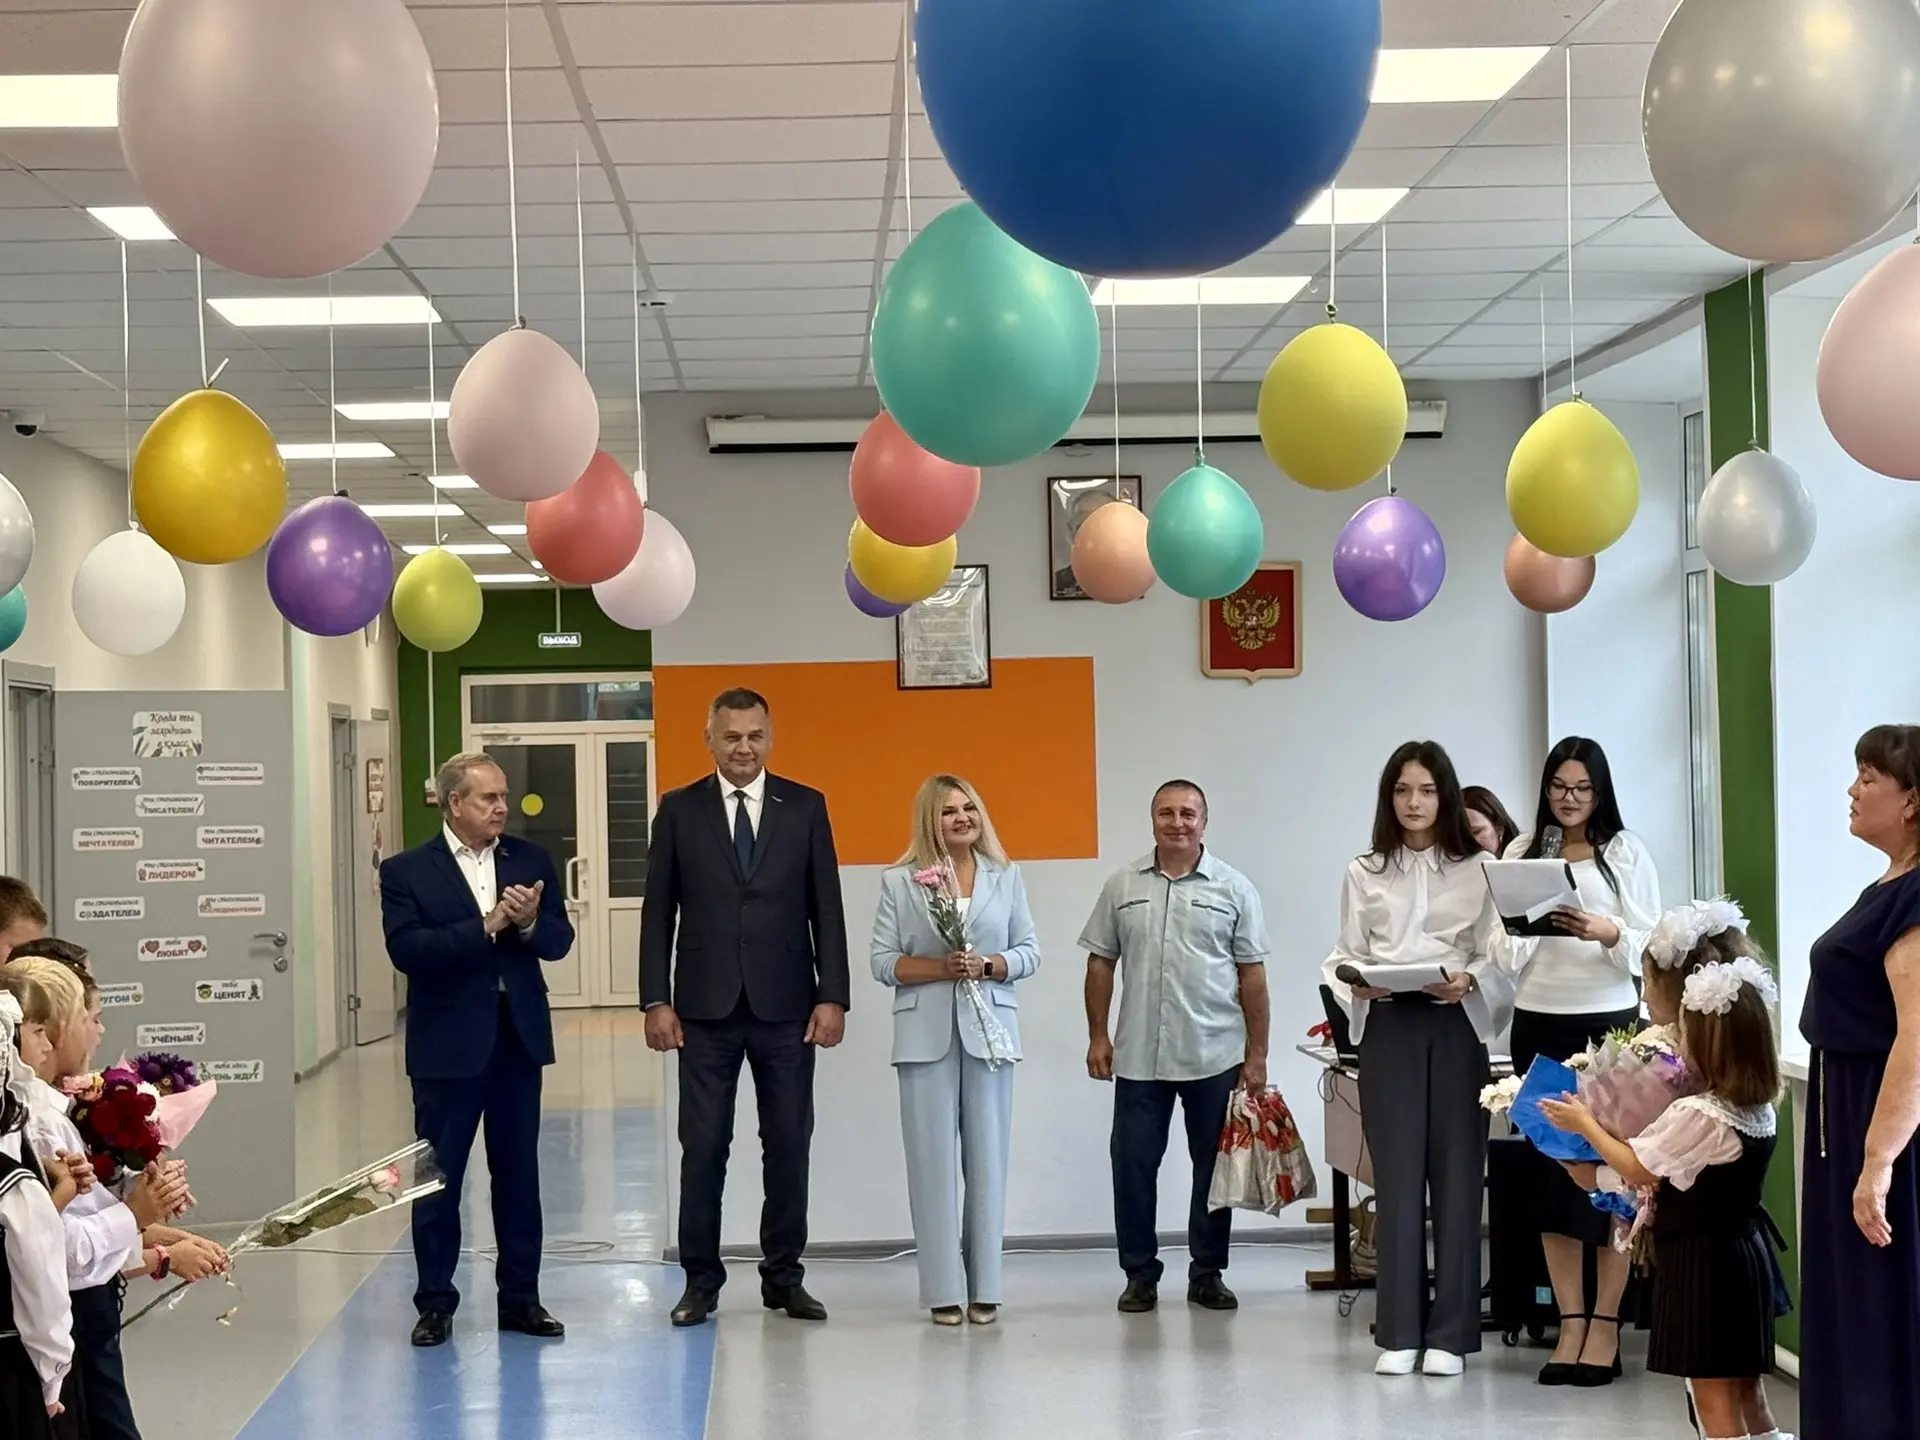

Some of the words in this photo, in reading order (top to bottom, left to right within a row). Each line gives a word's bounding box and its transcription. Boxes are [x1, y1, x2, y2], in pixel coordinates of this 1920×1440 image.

[542, 636, 579, 645] ВЫХОД
[149, 711, 177, 724] Когда
[179, 713, 195, 722] ты
[78, 779, 135, 787] ПОКОРИТЕЛЕМ
[144, 807, 195, 815] ПИСАТЕЛЕМ
[78, 839, 135, 848] МЕЧТАТЕЛЕМ
[201, 836, 256, 845] ЧИТАТЕЛЕМ
[147, 870, 197, 880] ЛИДЕРОМ
[79, 909, 141, 919] СОЗДАТЕЛЕМ
[156, 948, 189, 958] ЛЮБЯТ
[213, 990, 247, 1001] ЦЕНЯТ
[151, 1033, 194, 1044] УЧЁНЫМ
